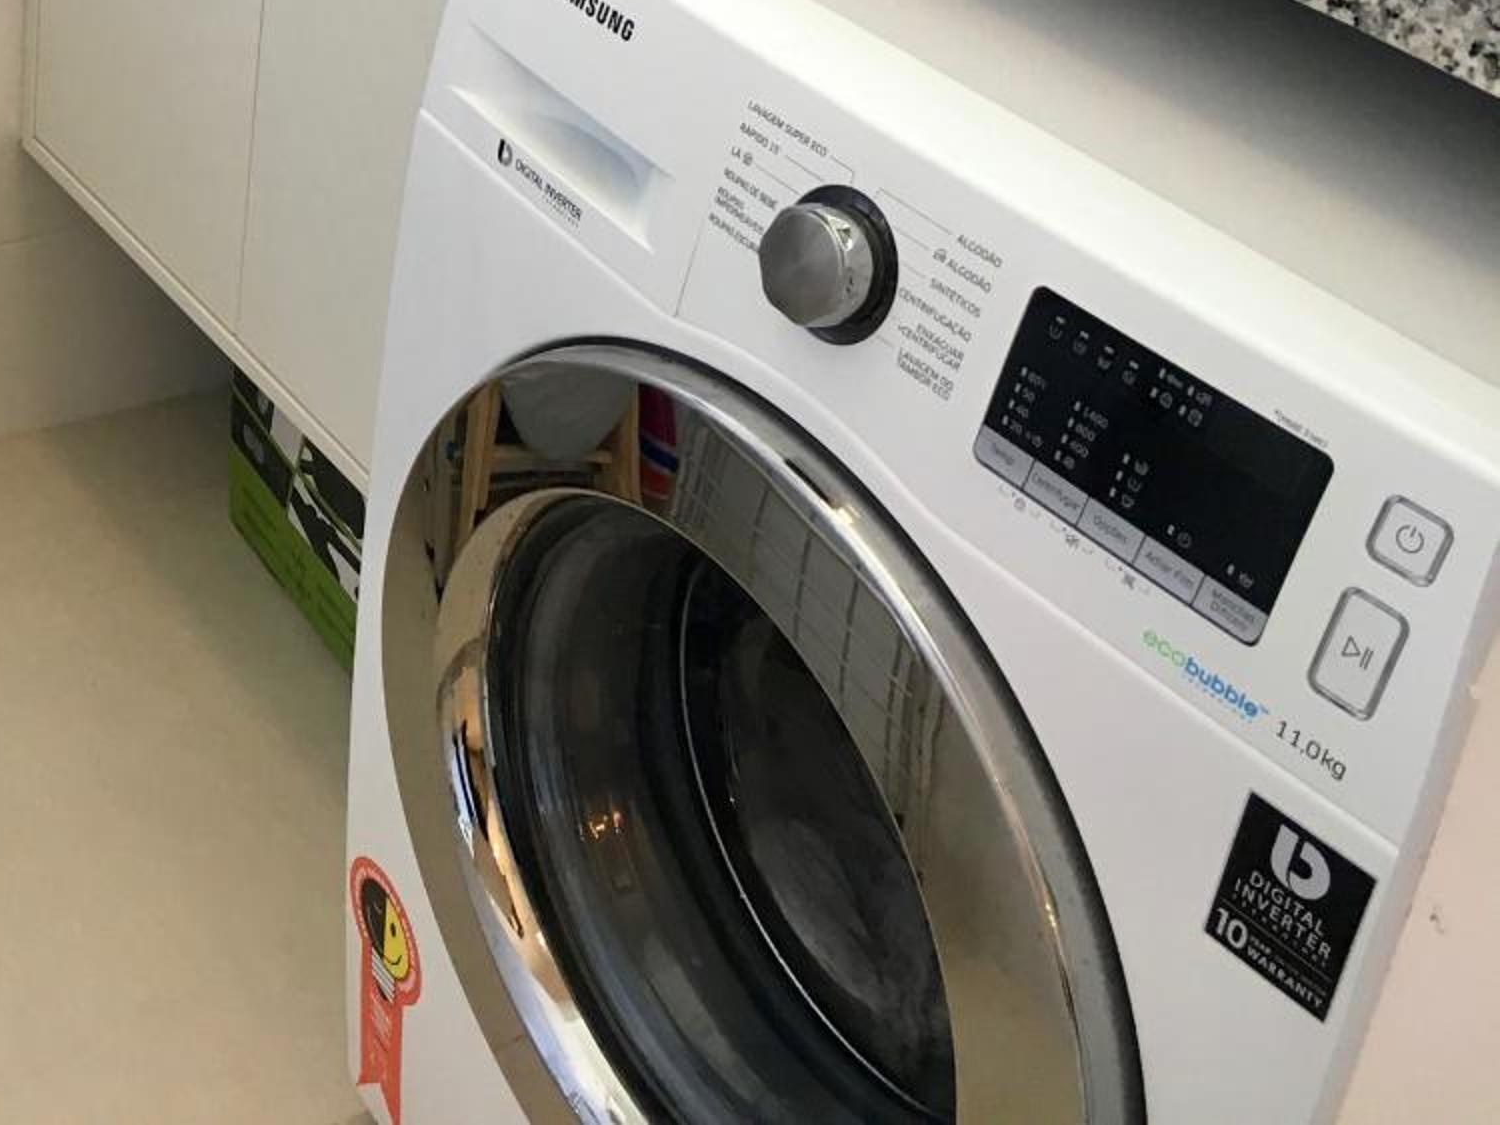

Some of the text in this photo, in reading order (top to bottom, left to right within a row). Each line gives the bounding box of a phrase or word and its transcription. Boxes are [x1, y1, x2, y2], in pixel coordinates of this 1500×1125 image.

[1142, 629, 1259, 718] ecobubble
[1216, 906, 1248, 950] 10
[1234, 876, 1332, 960] INVERTER
[1249, 870, 1324, 936] DIGITAL
[1247, 947, 1324, 1010] WARRANTY
